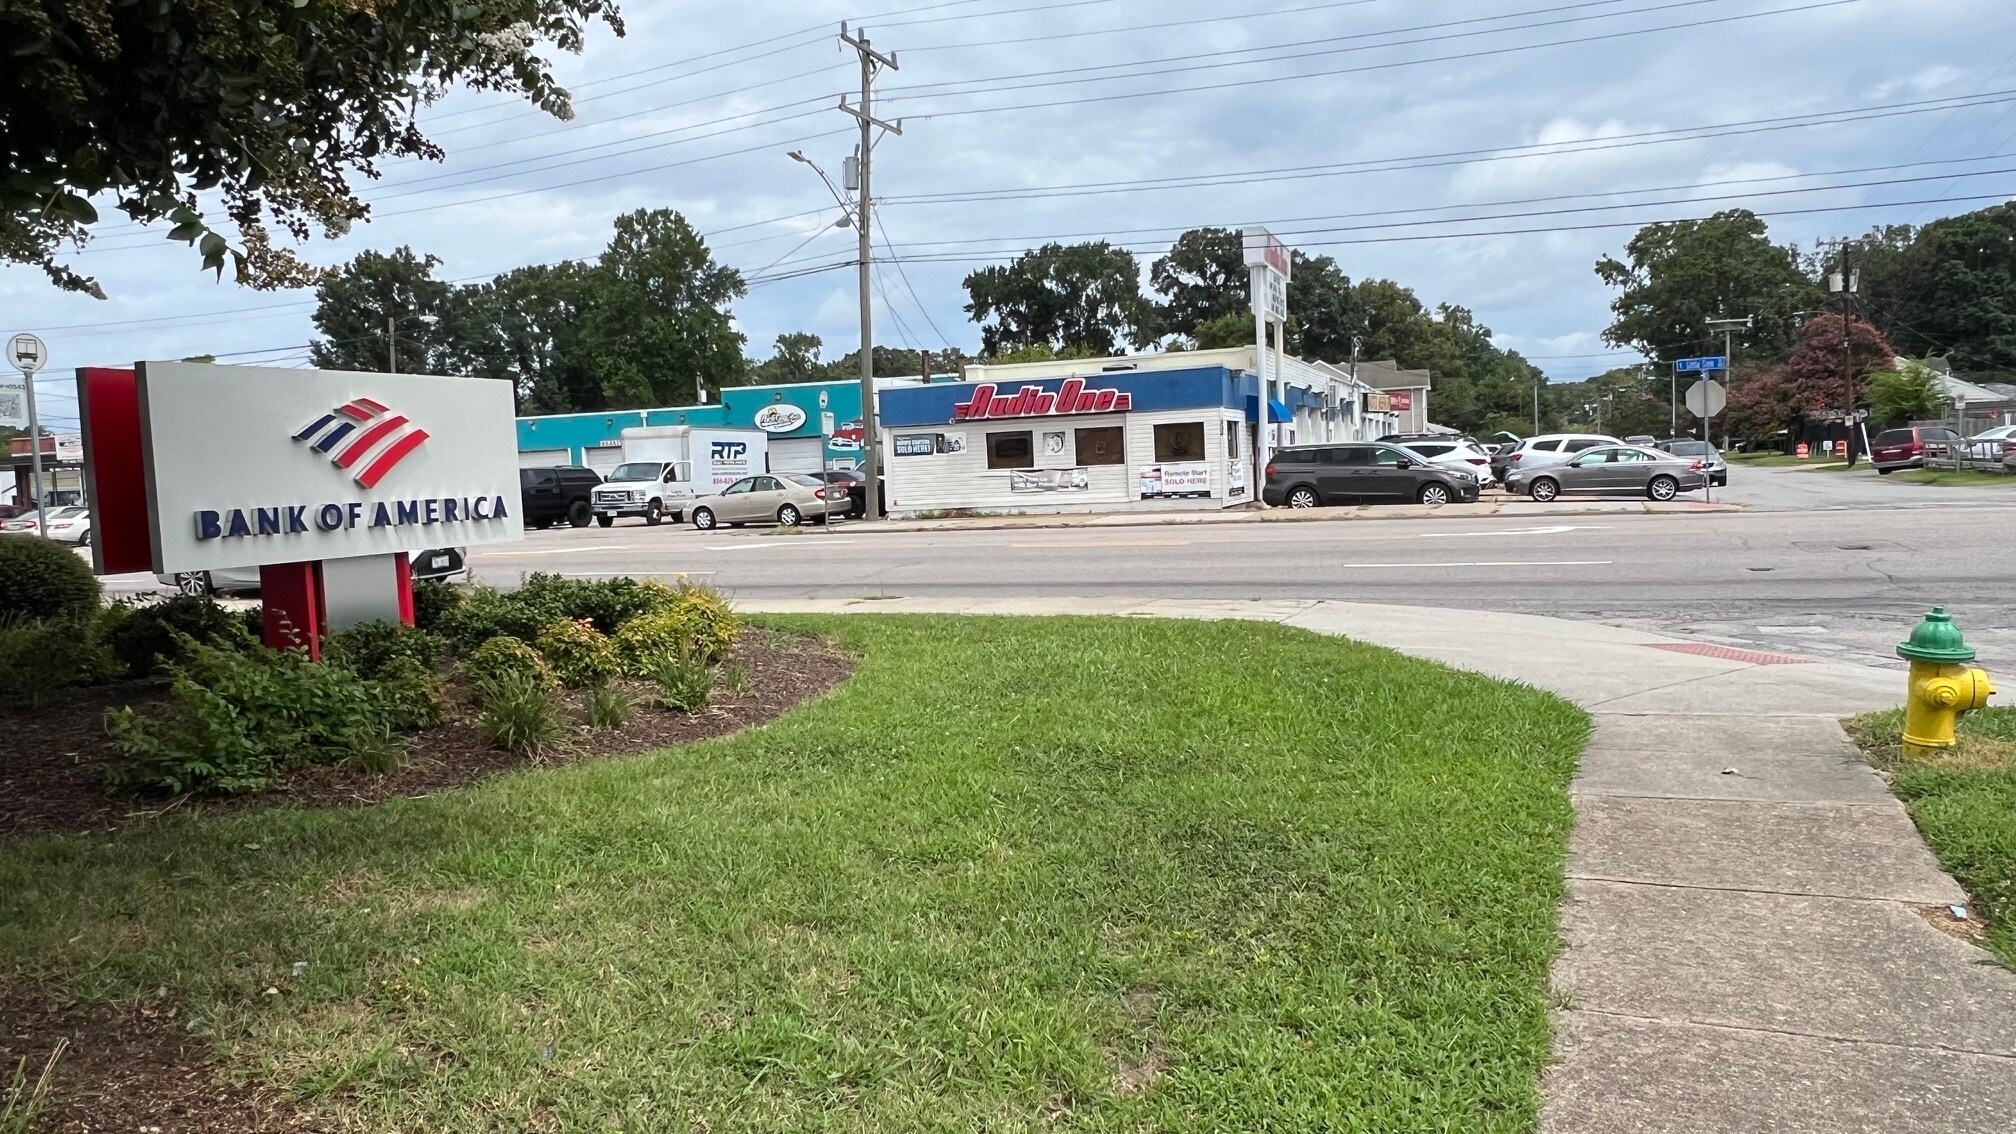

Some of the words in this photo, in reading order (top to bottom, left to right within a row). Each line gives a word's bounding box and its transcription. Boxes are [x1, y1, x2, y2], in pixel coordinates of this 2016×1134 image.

[968, 384, 1056, 418] Audio
[1054, 378, 1117, 412] One
[711, 441, 747, 460] RTP
[897, 445, 912, 454] SOLD
[1165, 478, 1185, 486] SOLD
[1186, 477, 1207, 485] HERE
[194, 506, 309, 539] BANK
[315, 503, 362, 531] OF
[368, 496, 508, 528] AMERICA
